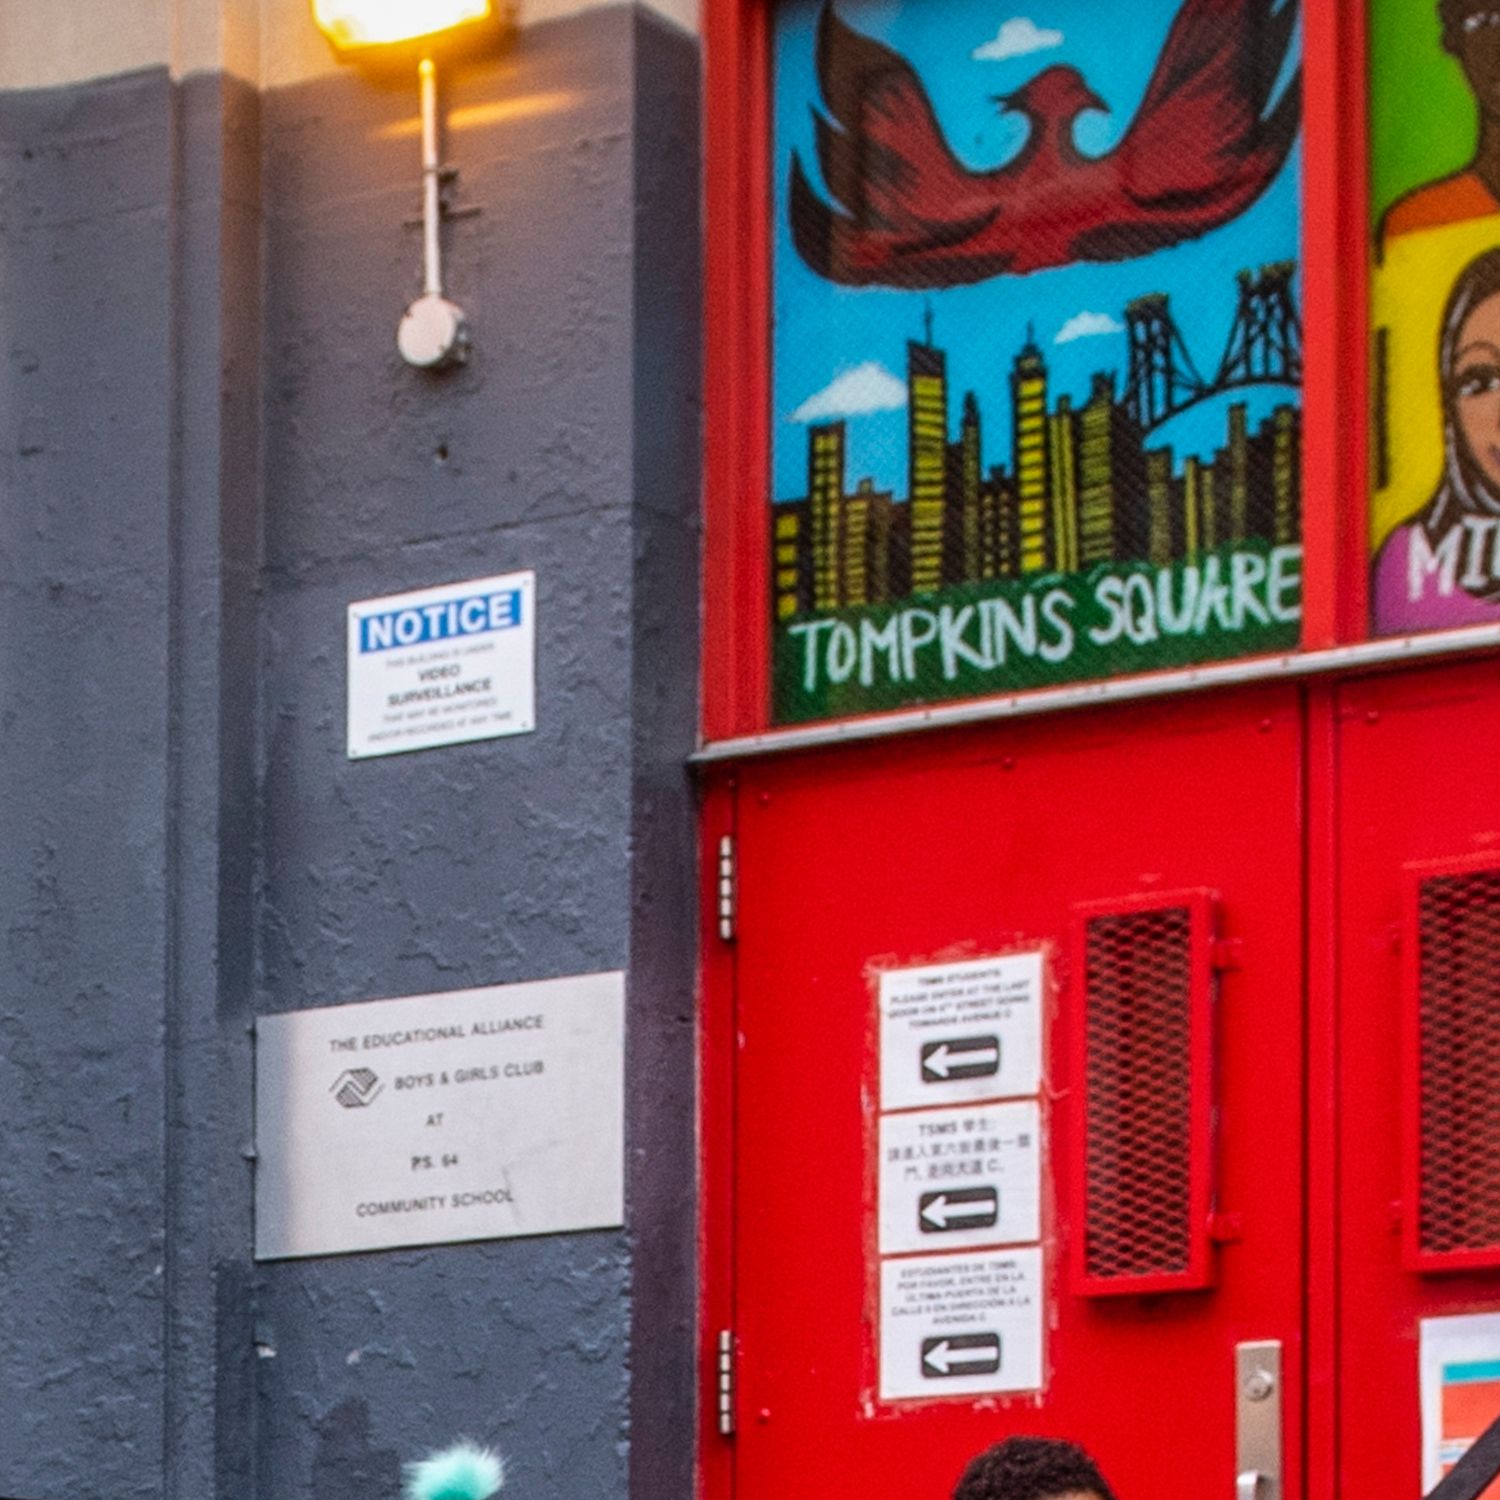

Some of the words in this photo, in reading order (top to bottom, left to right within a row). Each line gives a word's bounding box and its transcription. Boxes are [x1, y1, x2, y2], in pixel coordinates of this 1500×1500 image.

[366, 593, 514, 650] NOTICE
[789, 589, 1075, 692] TOMPKINS
[1089, 546, 1304, 645] SQUARE
[418, 664, 460, 681] VIDEO
[388, 678, 491, 706] SURVEILLANCE
[329, 1037, 358, 1053] THE
[362, 1024, 466, 1051] EDUCATIONAL
[471, 1014, 545, 1037] ALLIANCE
[394, 1071, 435, 1091] BOYS
[439, 1071, 450, 1086] &
[454, 1064, 500, 1085] GIRLS
[504, 1060, 545, 1078] CLUB
[425, 1113, 444, 1128] AT
[356, 1194, 446, 1218] COMMUNITY
[451, 1188, 514, 1208] SCHOOL
